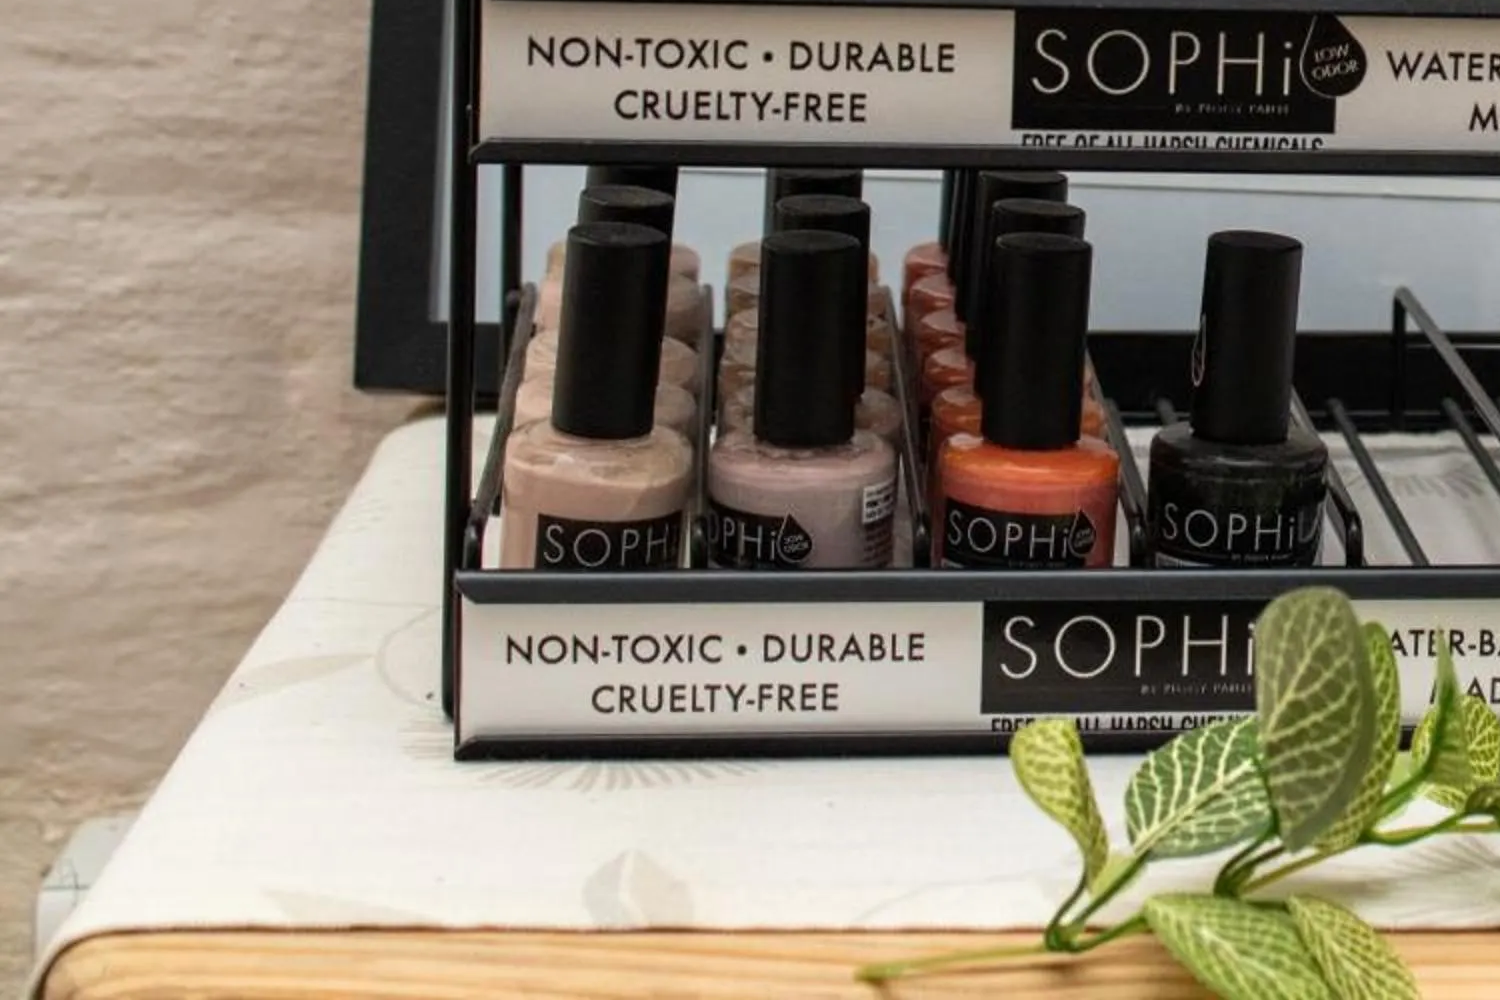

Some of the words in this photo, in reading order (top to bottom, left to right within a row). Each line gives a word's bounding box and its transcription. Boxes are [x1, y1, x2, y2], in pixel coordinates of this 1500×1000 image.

[527, 36, 748, 71] NON-TOXIC
[790, 41, 955, 73] DURABLE
[1031, 29, 1294, 96] SOPHi
[614, 90, 867, 123] CRUELTY-FREE
[707, 510, 776, 561] OPHi
[948, 509, 1069, 559] SOPHi
[1162, 502, 1295, 551] SOPHi
[505, 634, 722, 666] NON-TOXIC
[762, 632, 926, 663] DURABLE
[591, 683, 839, 714] CRUELTY-FREE
